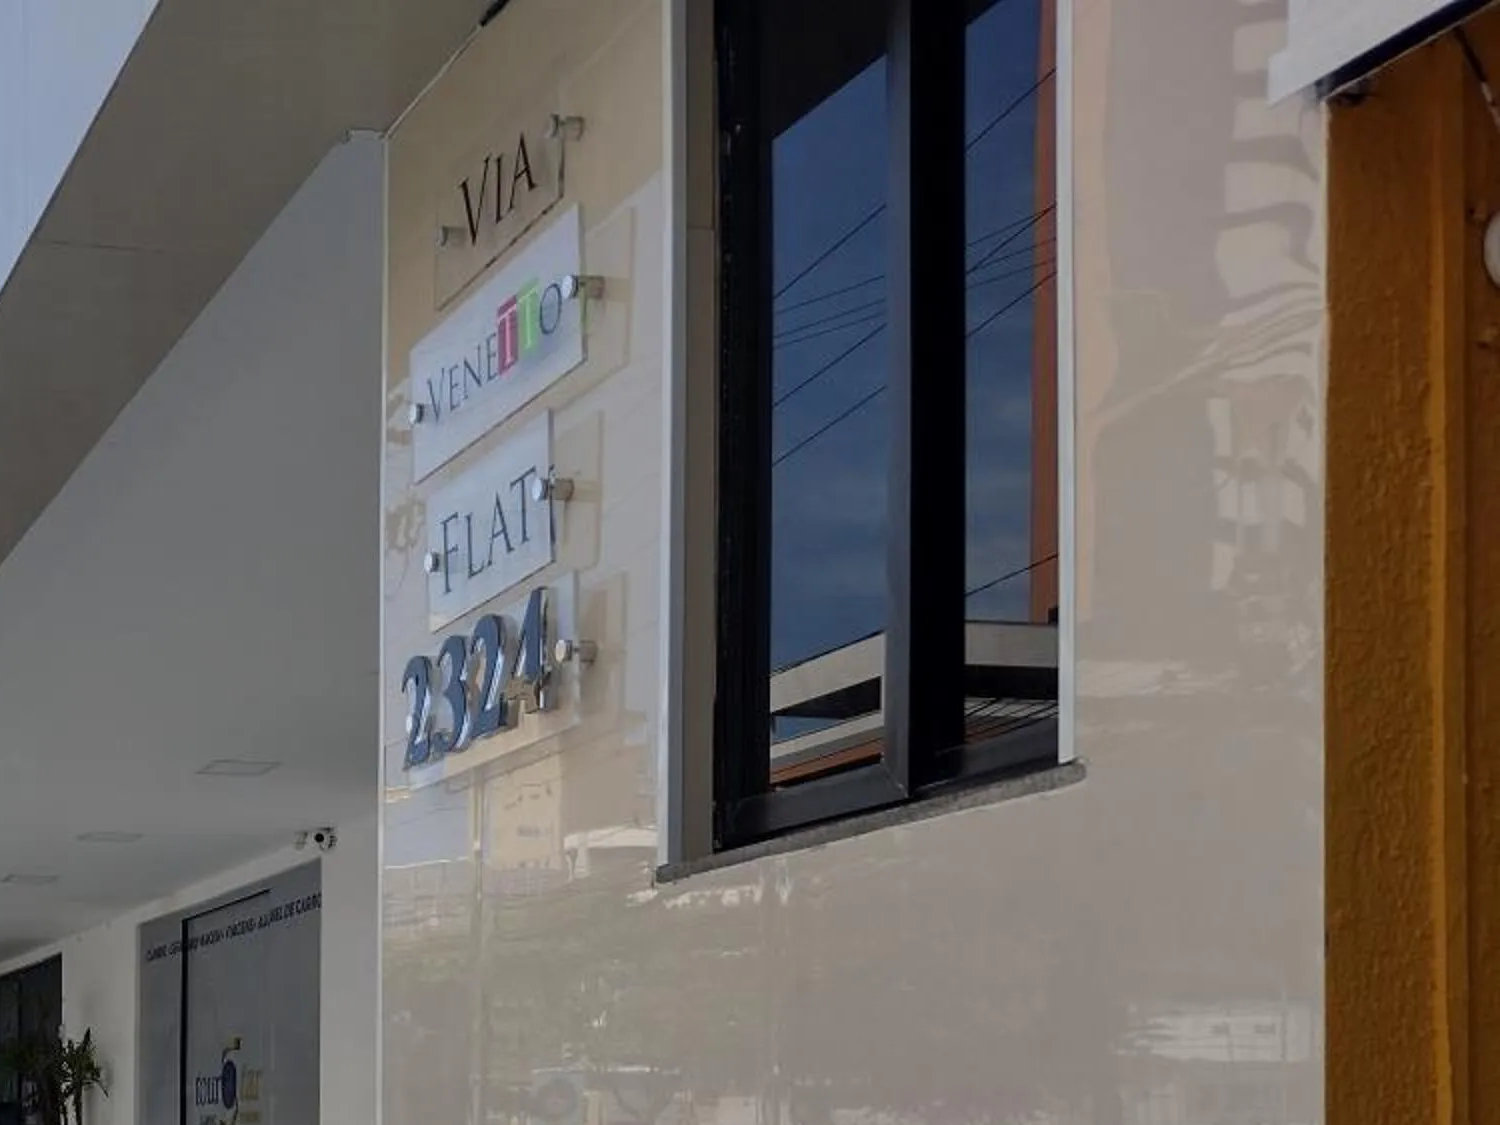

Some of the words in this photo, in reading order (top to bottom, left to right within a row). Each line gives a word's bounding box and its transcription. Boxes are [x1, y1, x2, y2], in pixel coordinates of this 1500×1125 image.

[458, 131, 538, 246] VIA
[425, 275, 563, 424] VENETTO
[439, 465, 538, 594] FLAT
[401, 585, 549, 770] 2324
